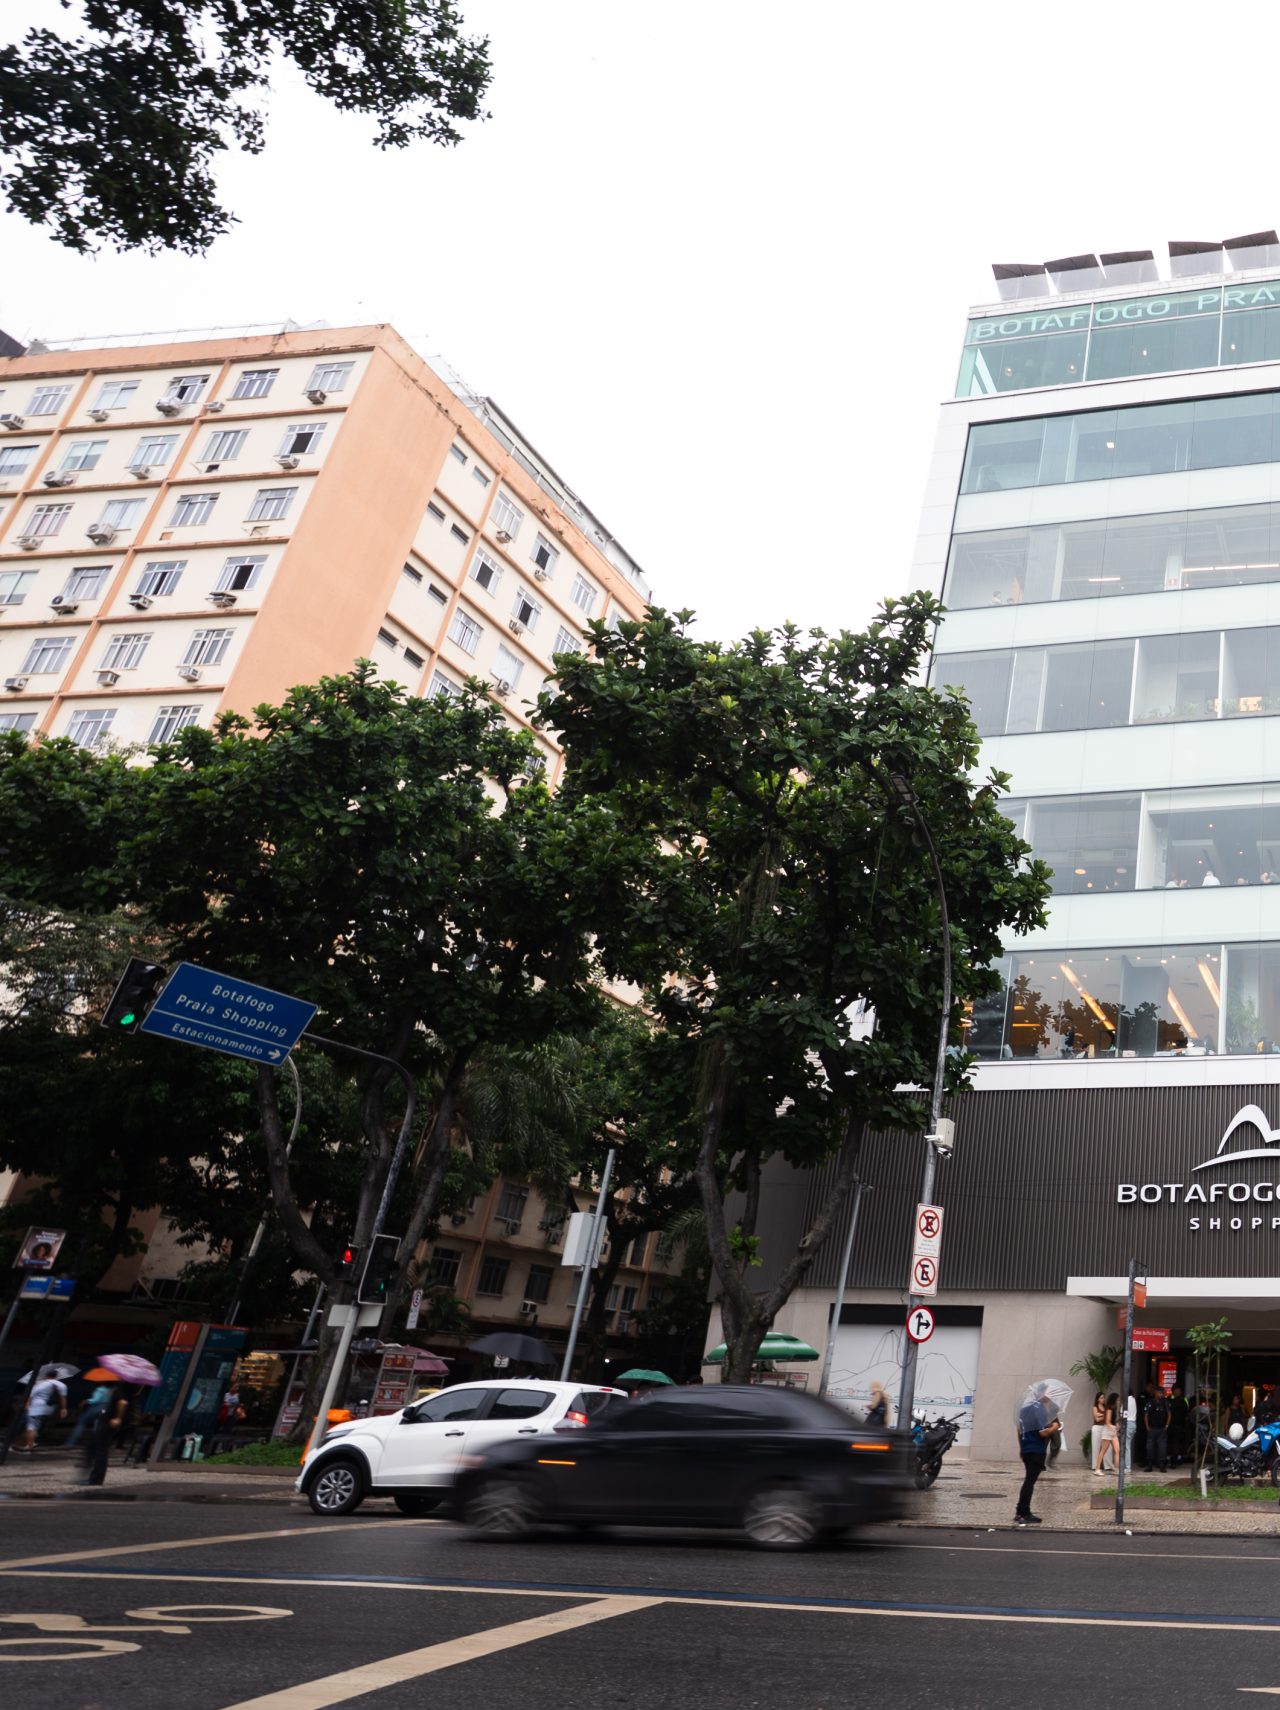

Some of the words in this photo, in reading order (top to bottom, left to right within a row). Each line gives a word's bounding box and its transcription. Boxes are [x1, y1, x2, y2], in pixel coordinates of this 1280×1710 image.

[975, 299, 1171, 339] BOTAFOGO
[176, 994, 215, 1015] Praia
[222, 1008, 288, 1037] Shopping
[212, 984, 274, 1012] Botafogo
[171, 1023, 263, 1055] Estacionamento
